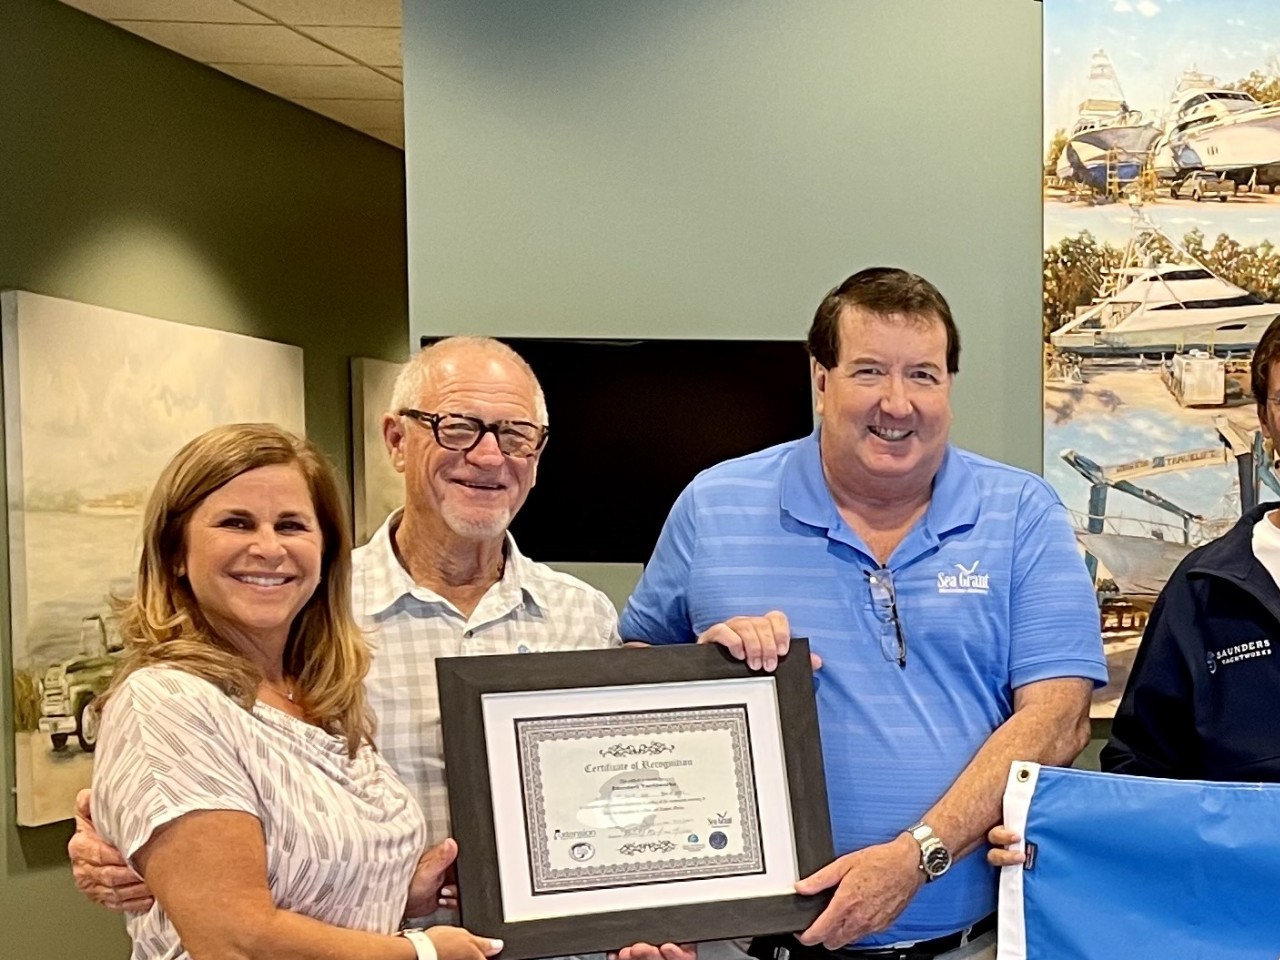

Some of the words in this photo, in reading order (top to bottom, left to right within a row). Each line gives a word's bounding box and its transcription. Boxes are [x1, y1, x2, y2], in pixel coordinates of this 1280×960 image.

[937, 571, 957, 588] Sea
[958, 571, 990, 589] Grant
[1216, 639, 1271, 660] SAUNDERS
